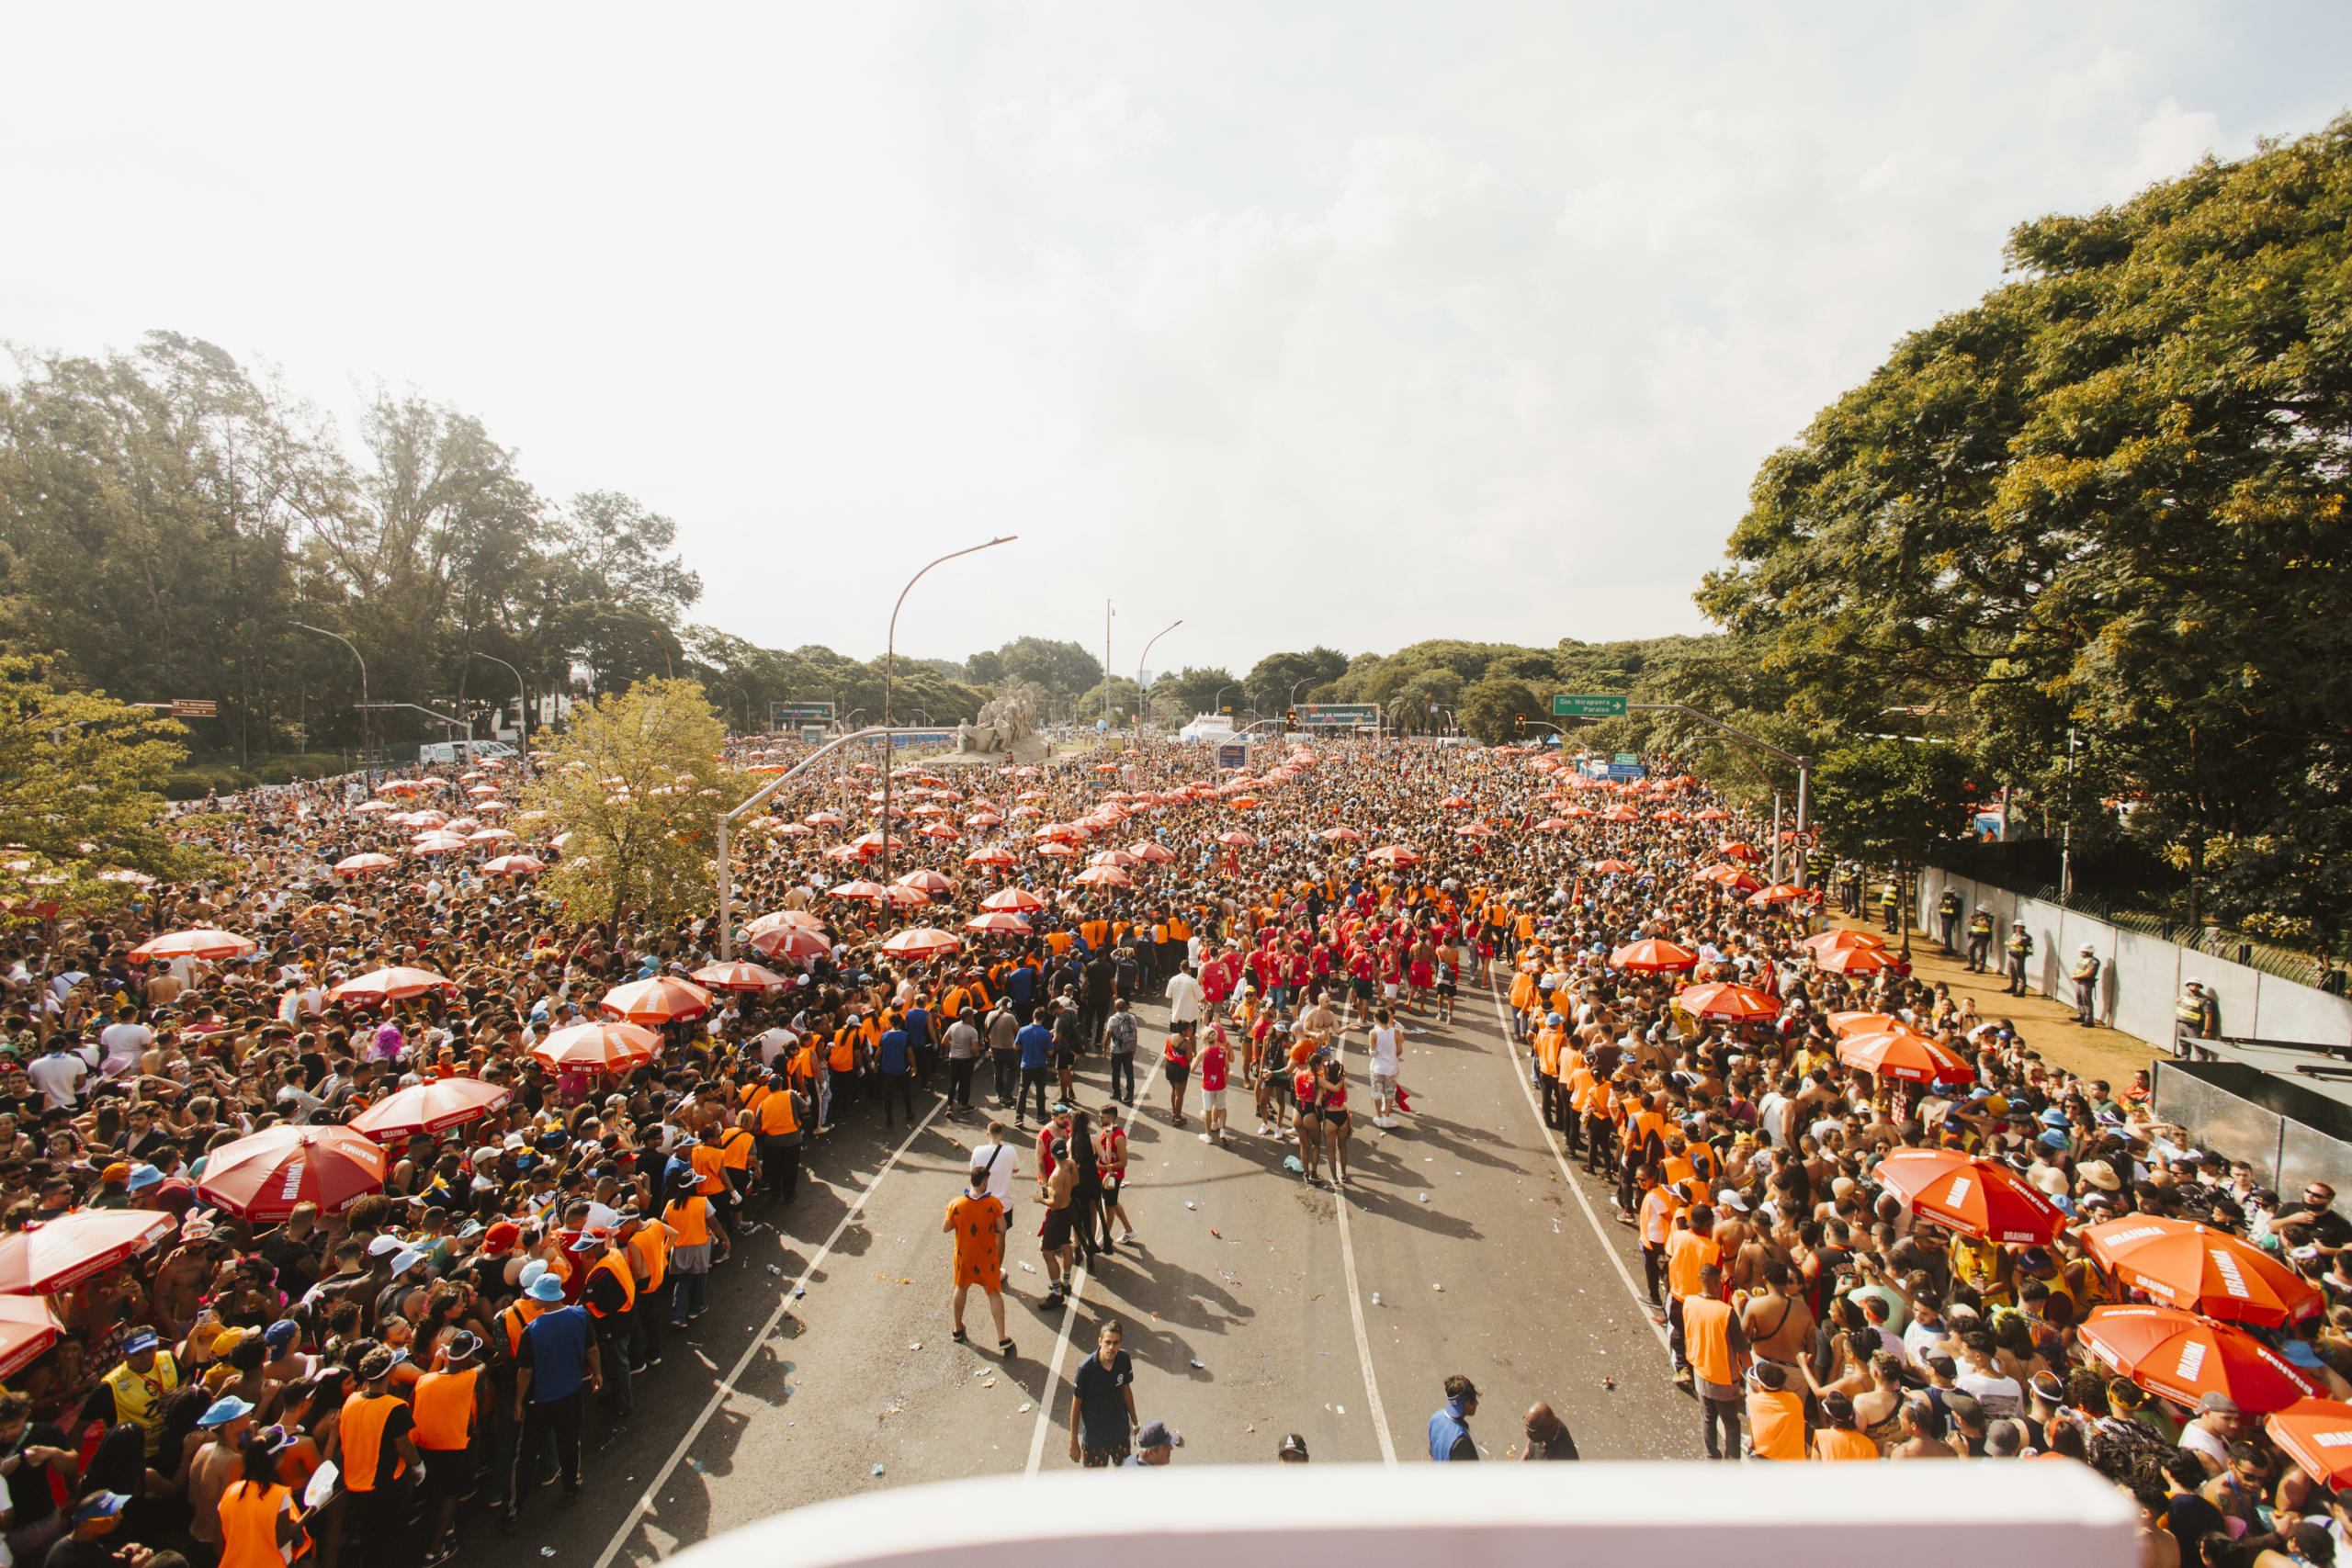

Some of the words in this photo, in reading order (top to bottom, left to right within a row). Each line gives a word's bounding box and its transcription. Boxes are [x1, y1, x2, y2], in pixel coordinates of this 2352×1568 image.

[1799, 835, 1807, 846] E
[340, 1142, 378, 1164] BRAHMA
[281, 1162, 305, 1201] BRAHMA
[1945, 1176, 1972, 1209] BRAHMA
[2008, 1178, 2050, 1213] BRAHMA
[340, 1191, 368, 1211] BRAHMA
[2003, 1231, 2034, 1242] BRAHMA
[2102, 1226, 2166, 1247] BRAHMA
[2136, 1274, 2175, 1298] BRAHMA
[2209, 1249, 2250, 1298] BRAHMA
[2176, 1340, 2206, 1382] BRAHMA
[2256, 1348, 2313, 1395] BRAHMA
